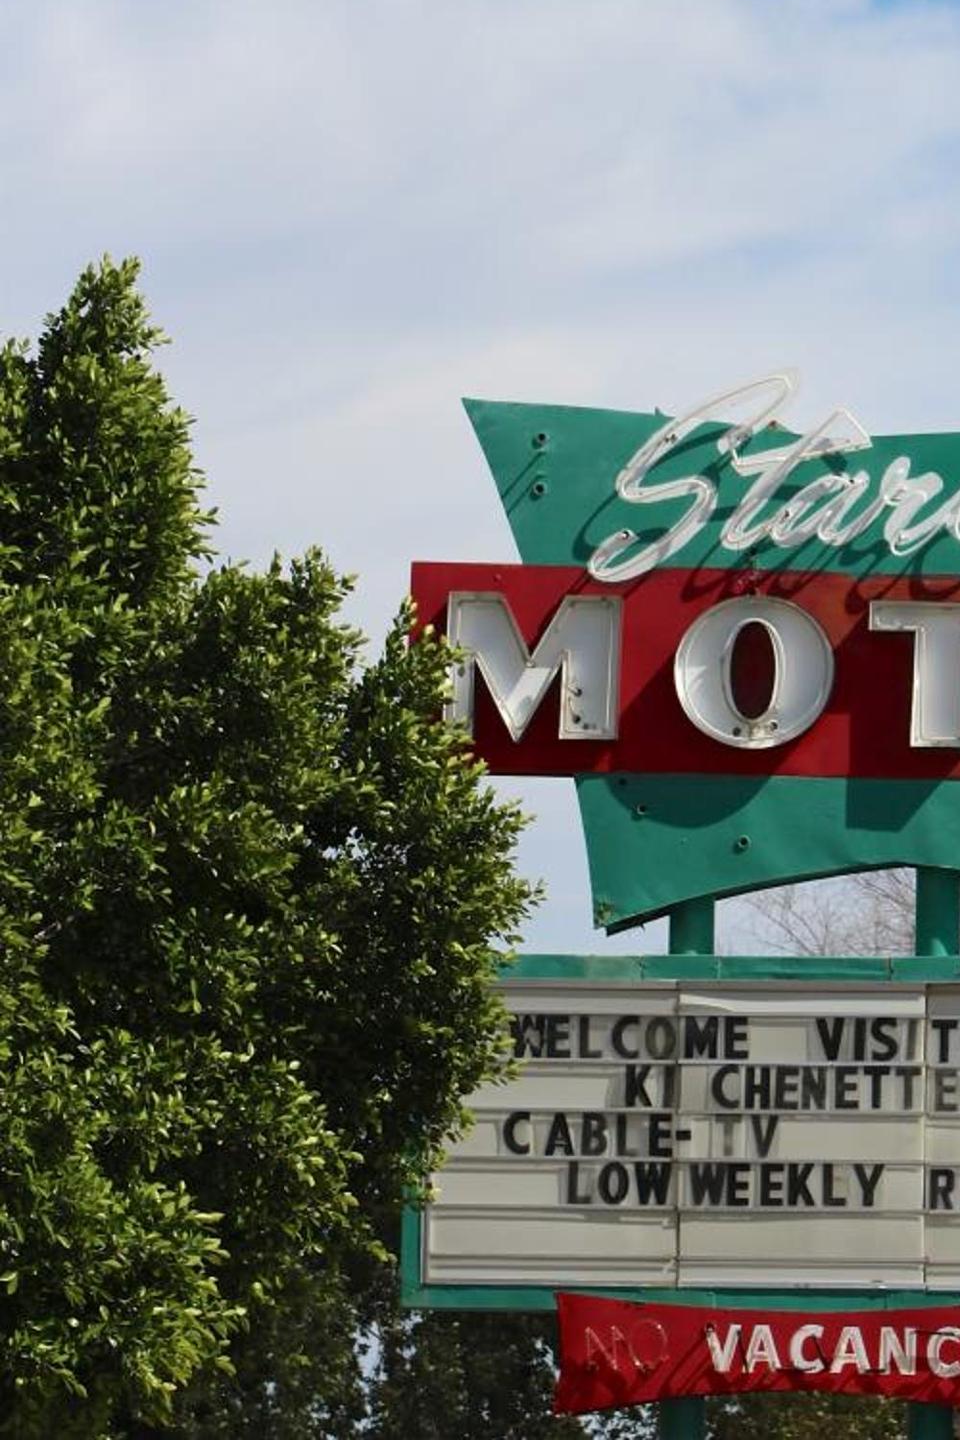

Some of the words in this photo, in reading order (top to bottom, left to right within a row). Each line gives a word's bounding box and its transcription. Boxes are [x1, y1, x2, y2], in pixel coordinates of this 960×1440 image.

[511, 1016, 749, 1060] WELCOME
[566, 1161, 672, 1206] LOW
[689, 1162, 885, 1208] WEEKLY
